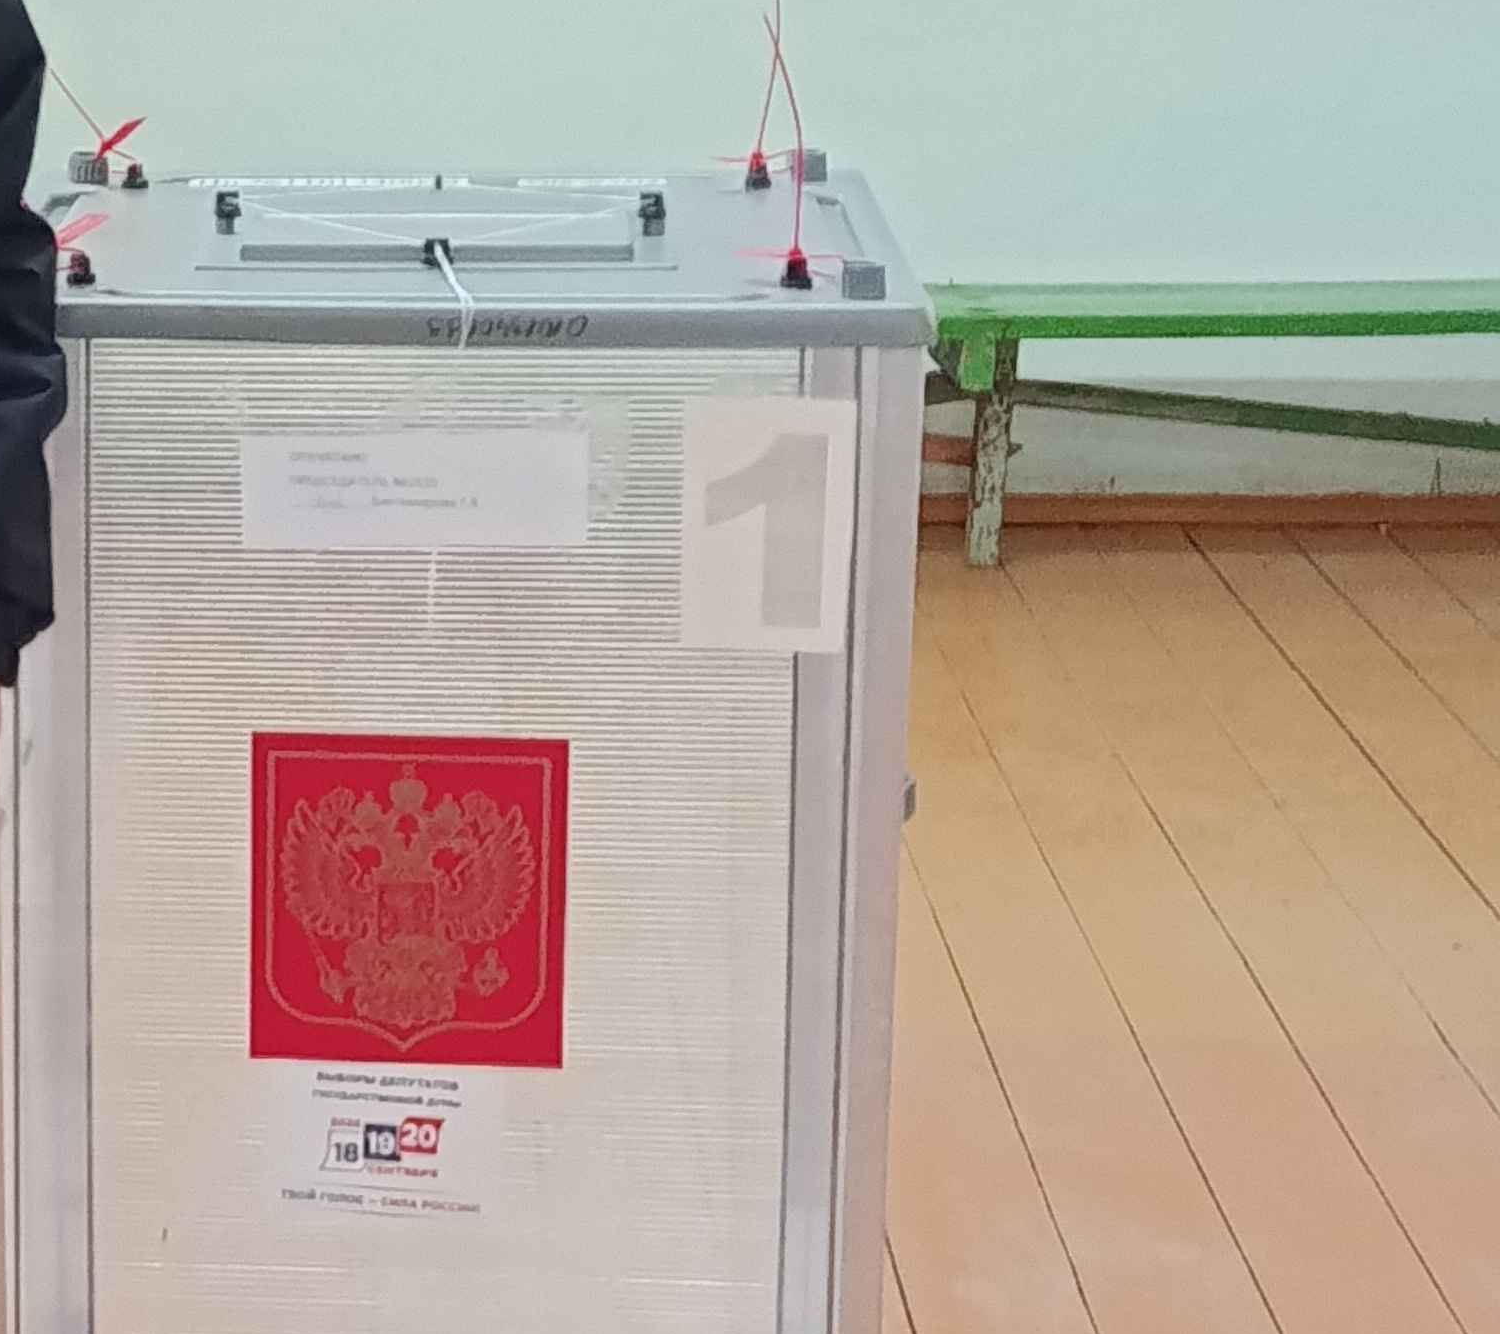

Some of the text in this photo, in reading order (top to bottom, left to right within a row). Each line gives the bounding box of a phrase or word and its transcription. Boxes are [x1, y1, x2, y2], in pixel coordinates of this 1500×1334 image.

[704, 433, 829, 628] 1
[333, 1142, 359, 1163] 18
[401, 1123, 437, 1149] 20
